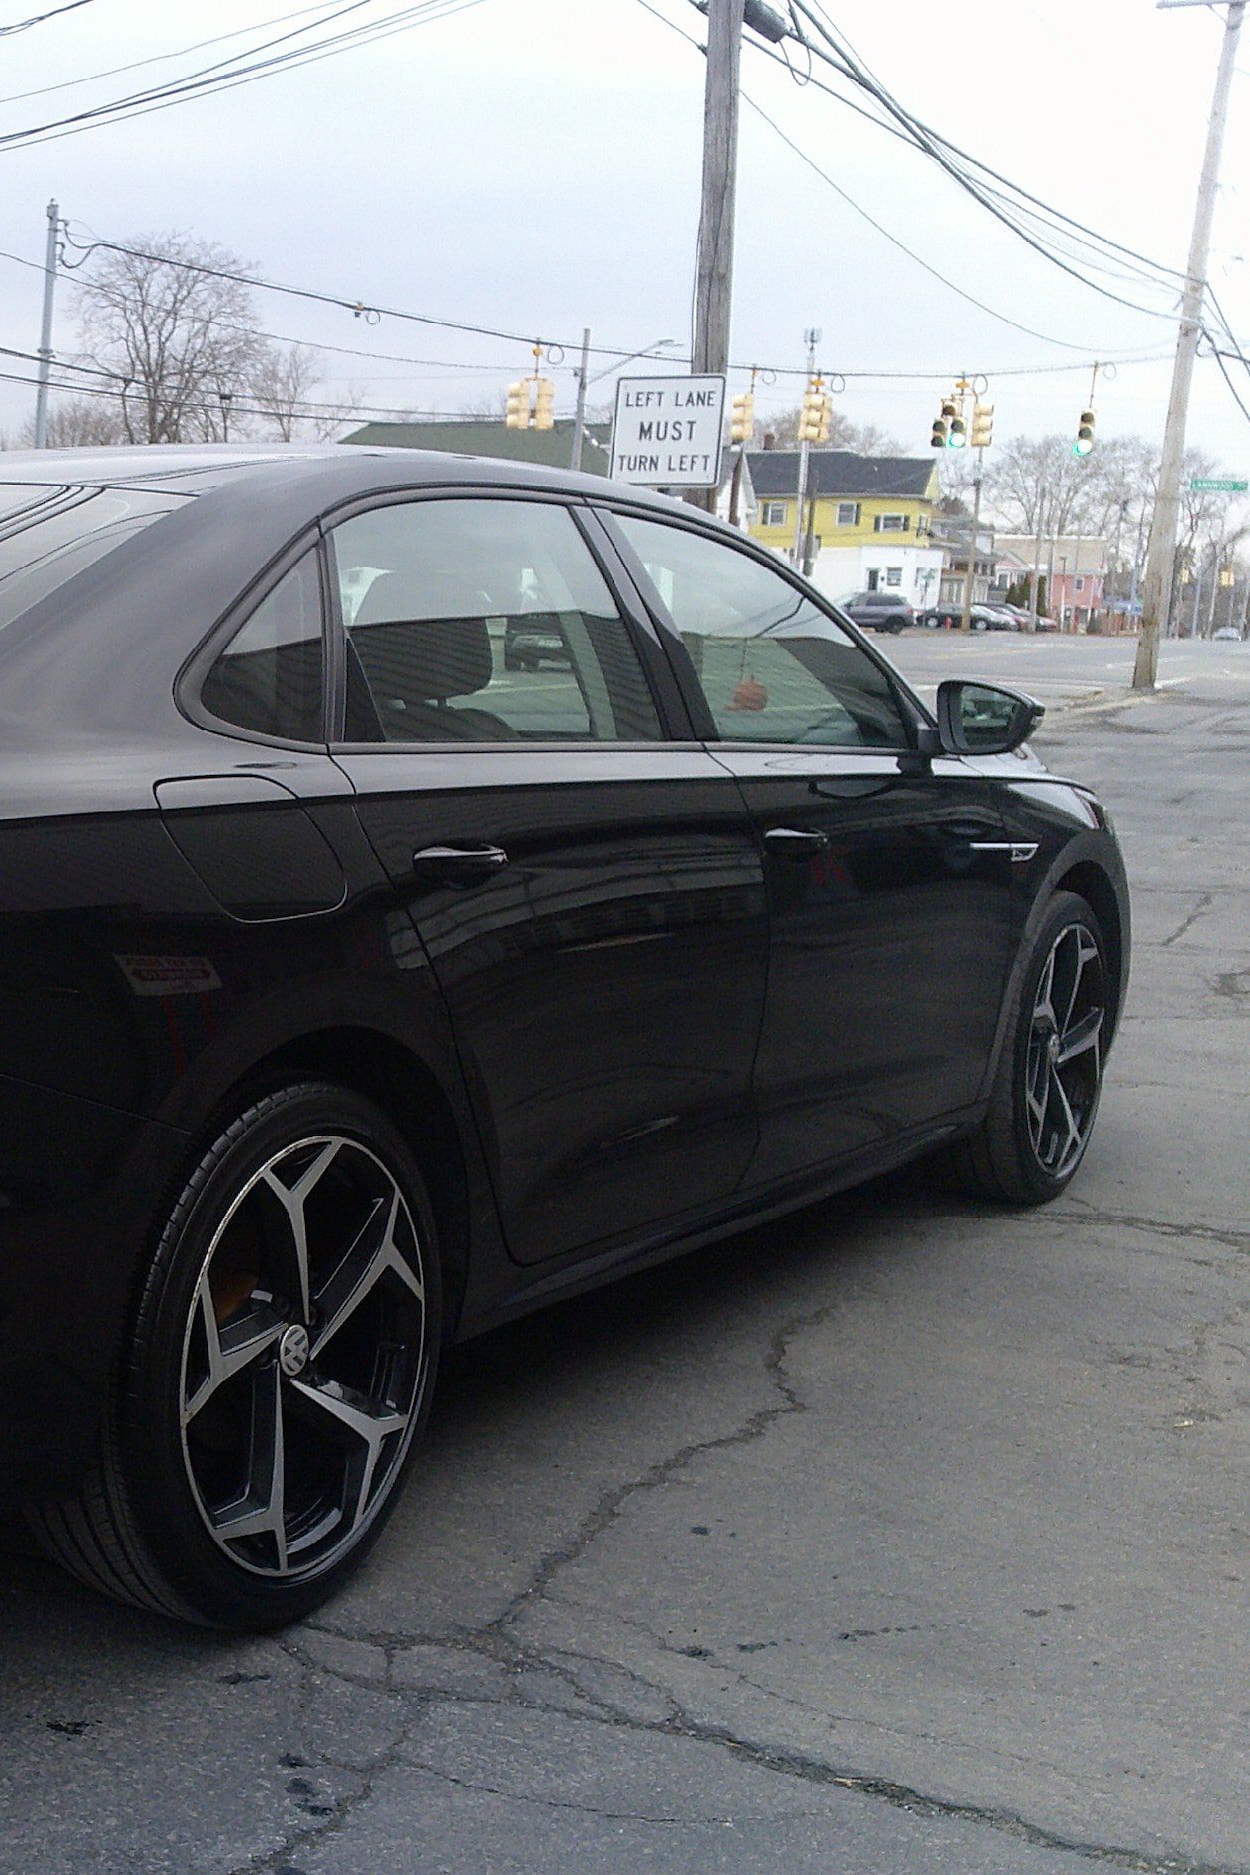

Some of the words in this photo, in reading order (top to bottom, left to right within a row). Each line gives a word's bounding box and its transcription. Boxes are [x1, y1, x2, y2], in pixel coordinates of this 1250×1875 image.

[625, 391, 665, 407] LEFT
[675, 390, 716, 407] LANE
[639, 420, 697, 441] MUST
[618, 455, 659, 472] TURN
[668, 455, 710, 472] LEFT
